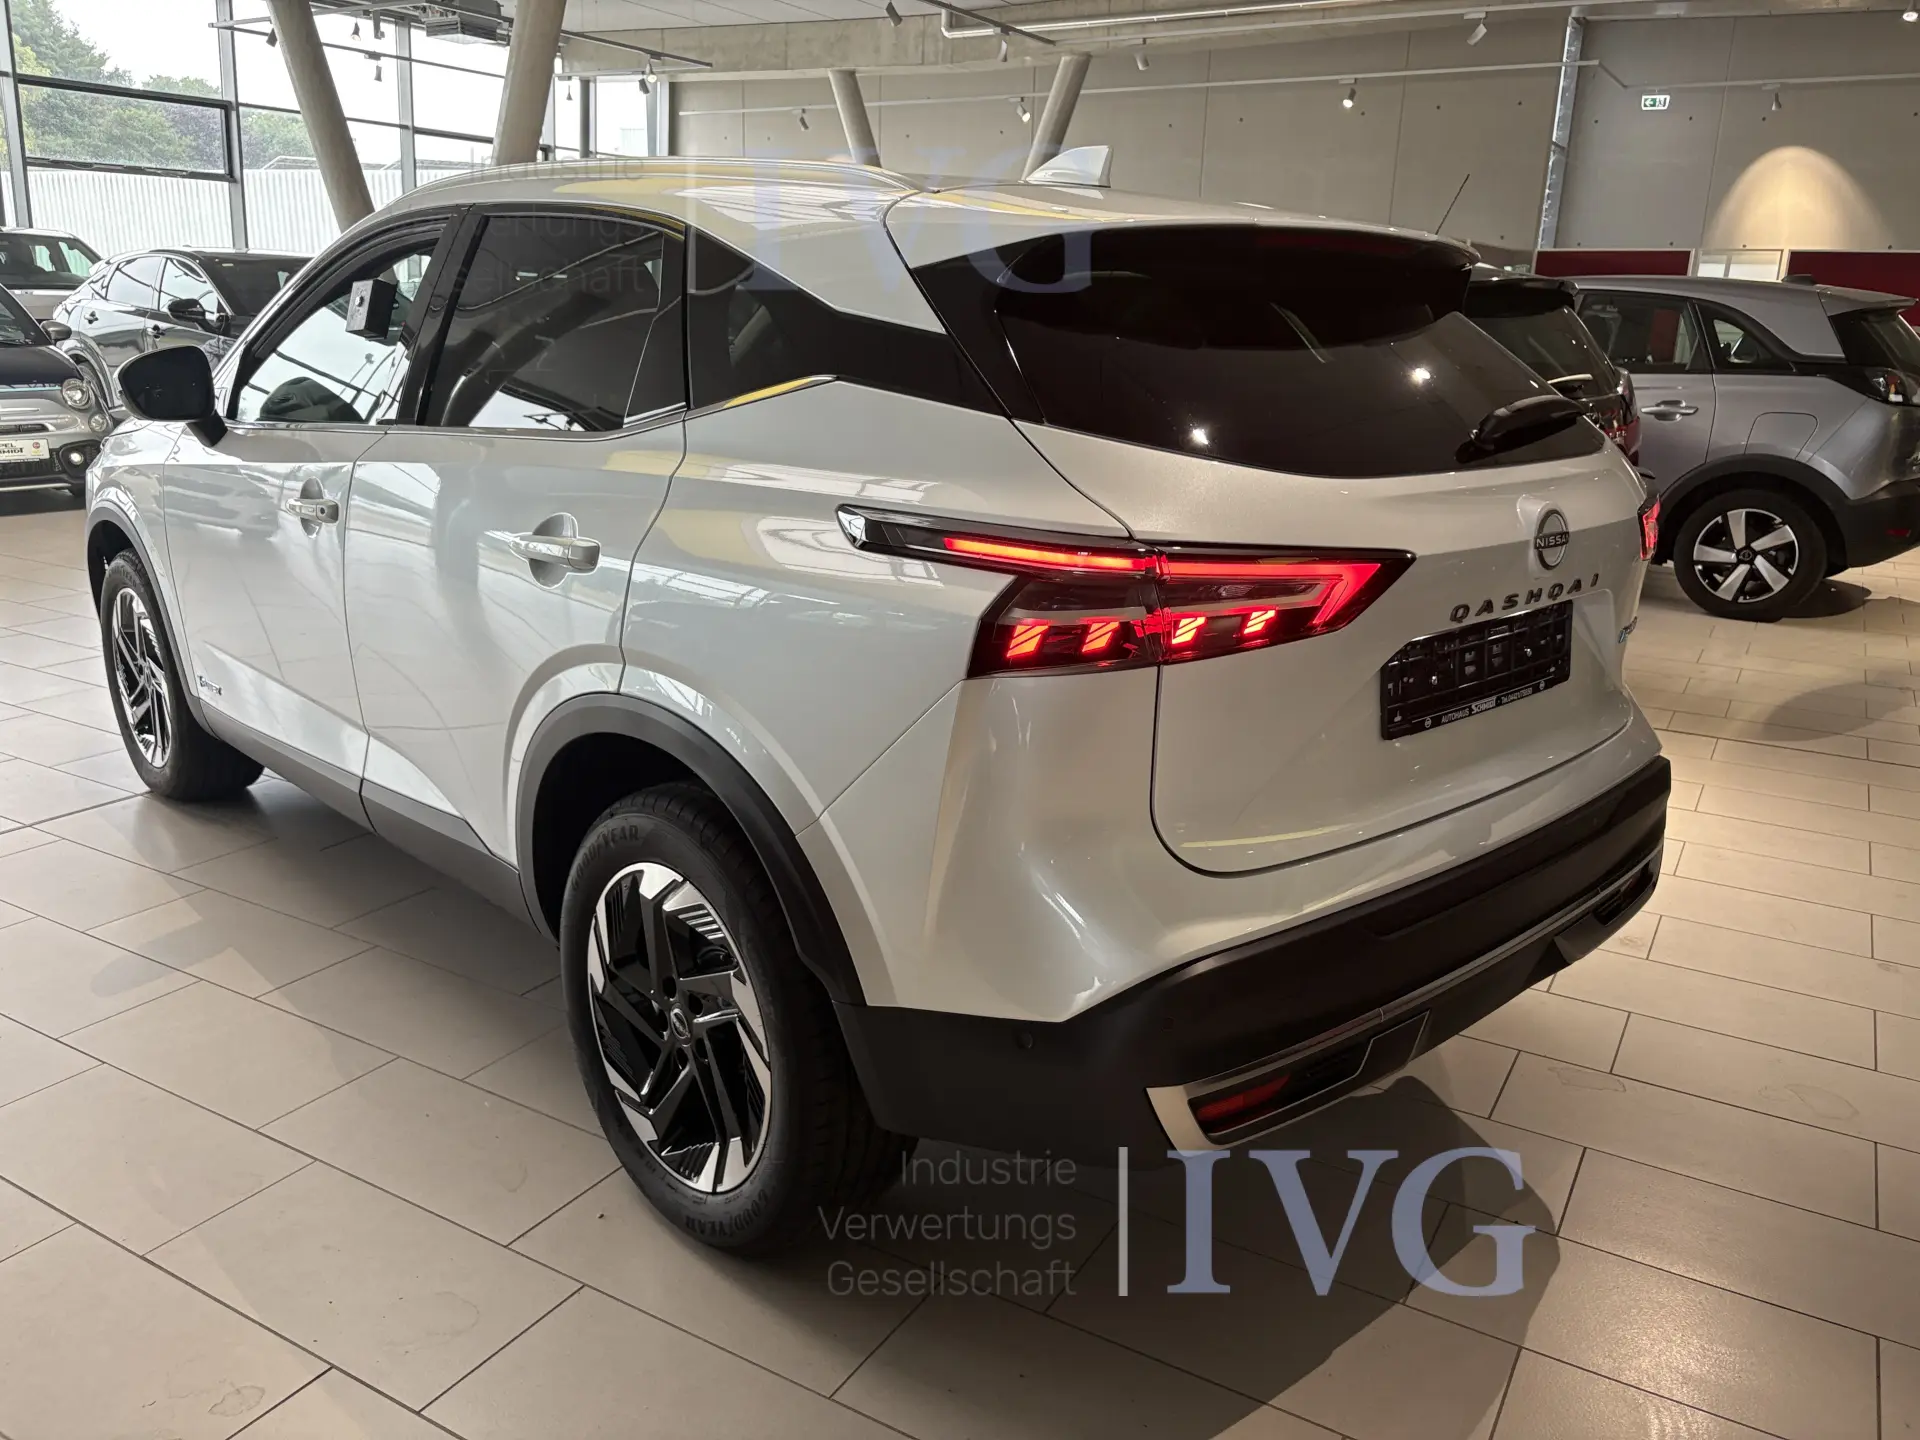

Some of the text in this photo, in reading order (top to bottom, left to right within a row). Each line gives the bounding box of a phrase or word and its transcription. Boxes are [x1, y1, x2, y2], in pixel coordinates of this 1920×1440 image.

[1450, 573, 1600, 623] QASHQAI
[1441, 707, 1470, 723] AUTOHAUS
[1471, 696, 1497, 714] SCHMIDT
[571, 824, 640, 891] GOODYEAR
